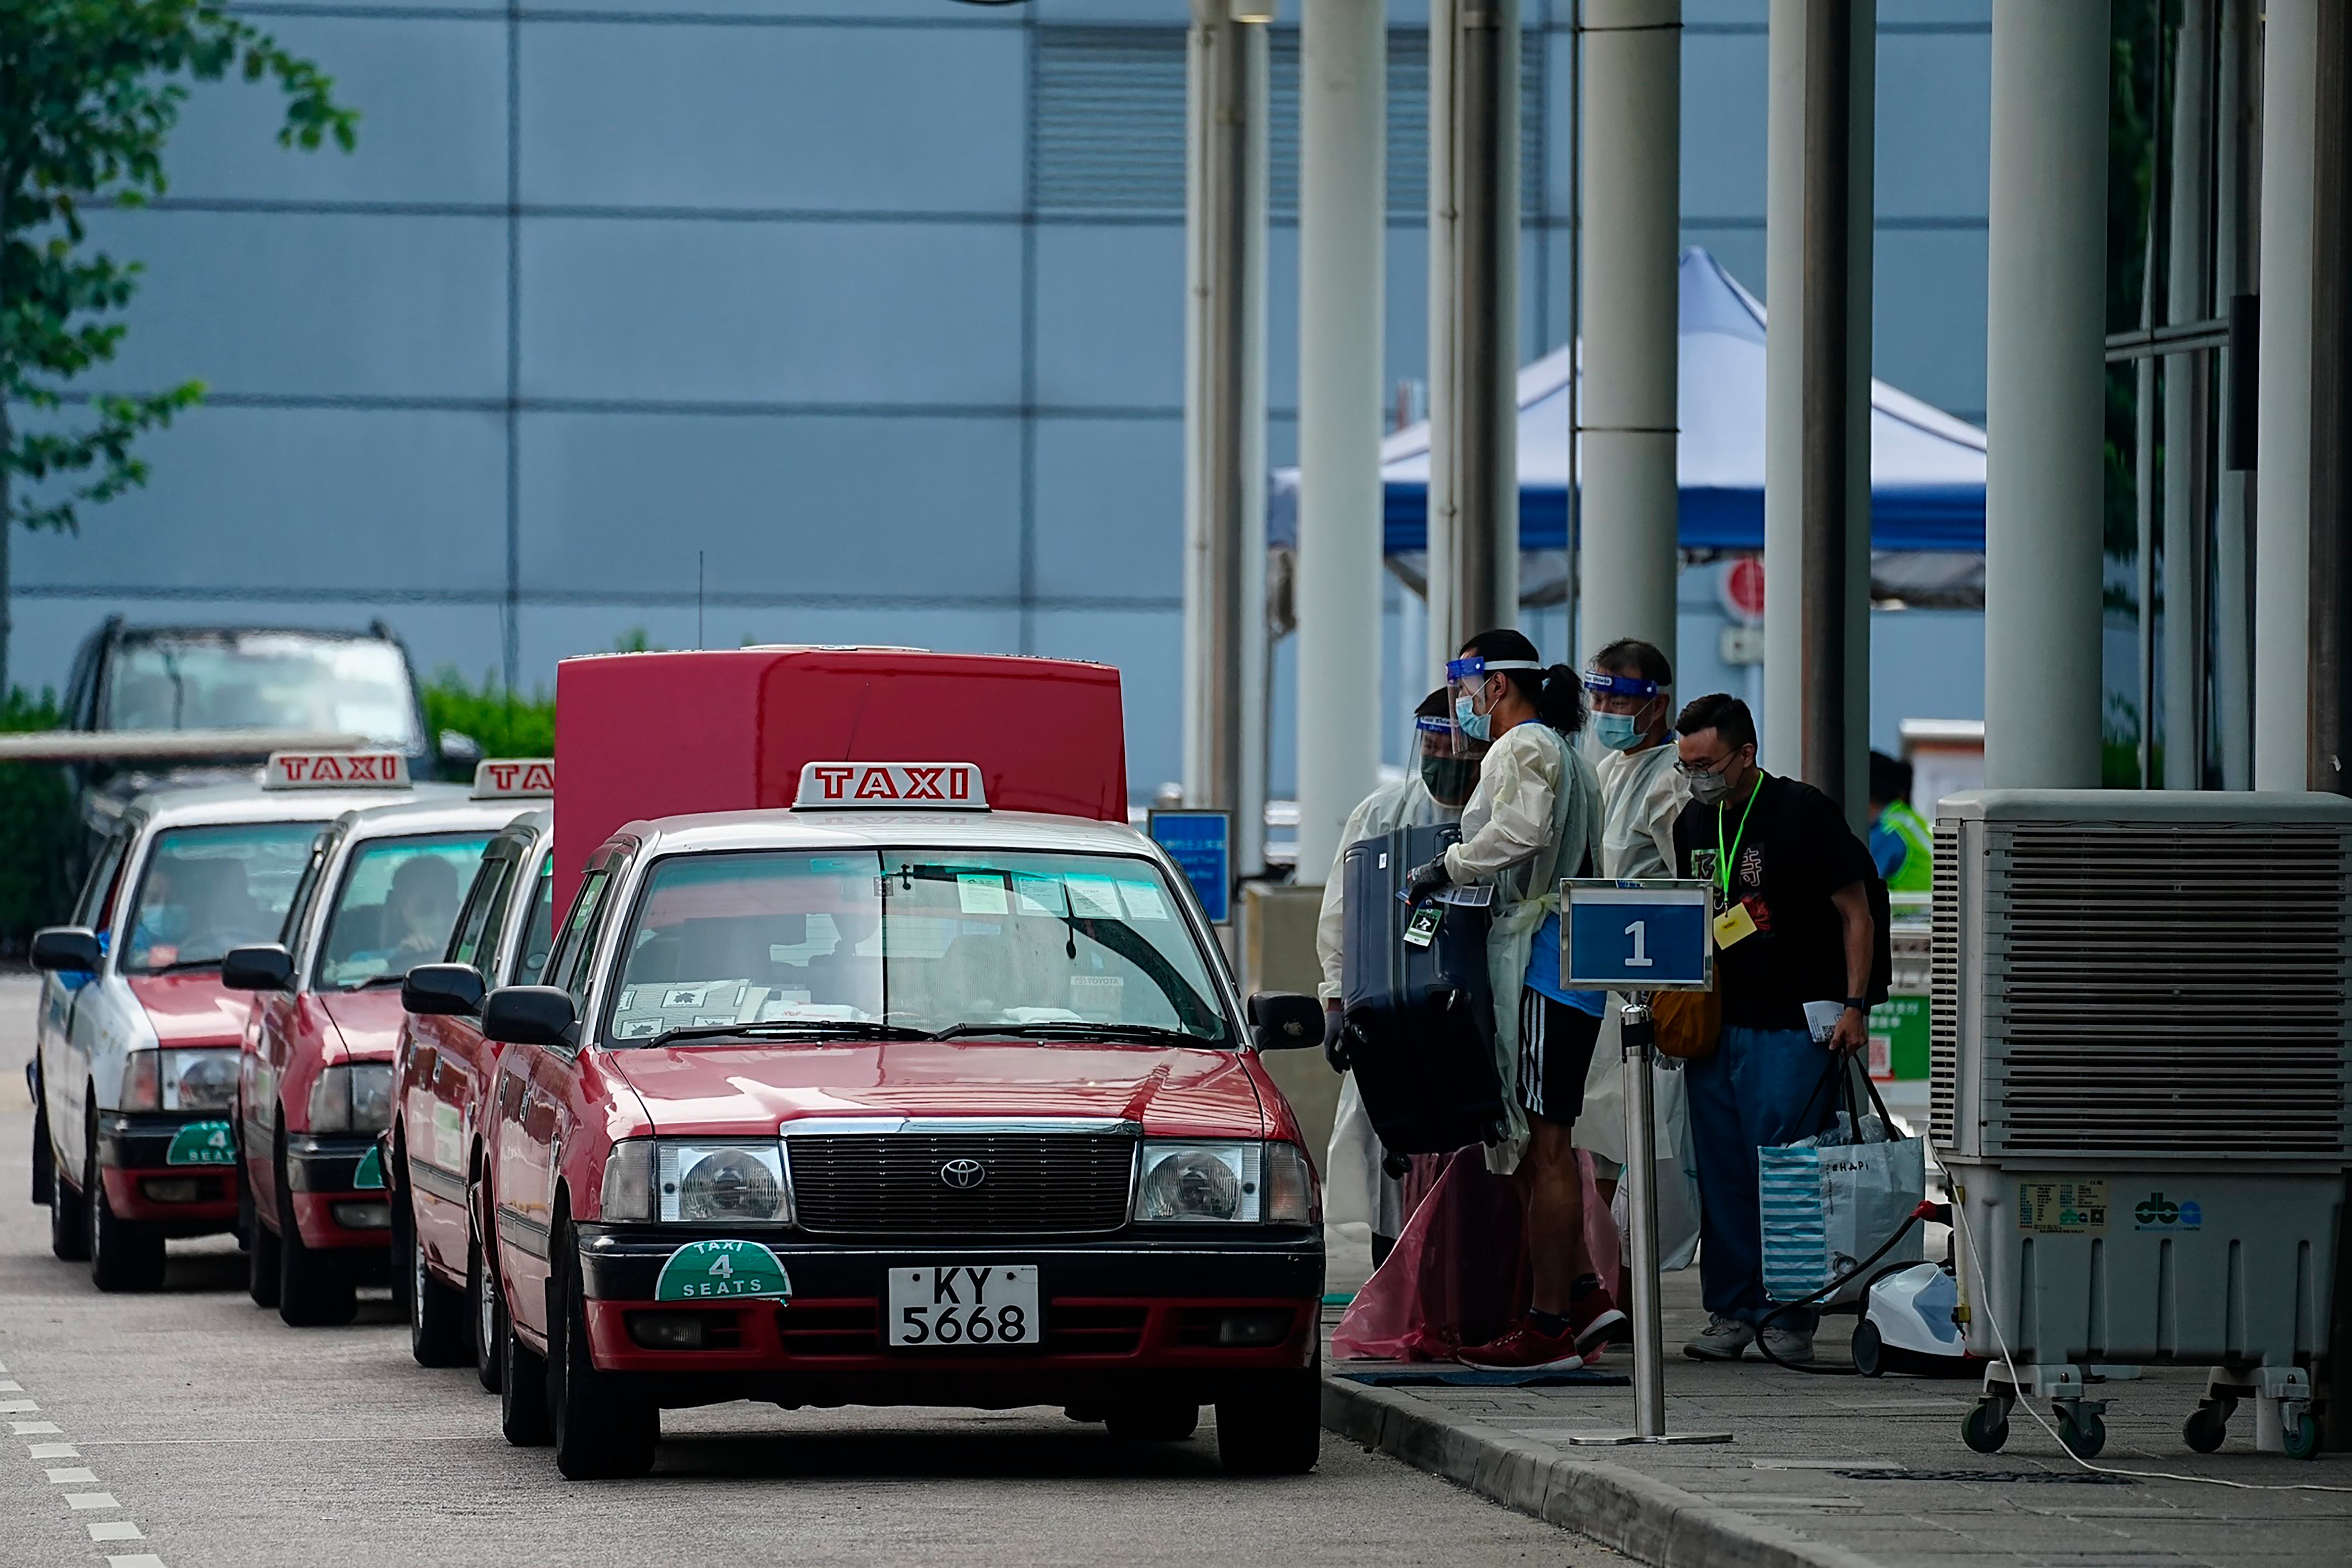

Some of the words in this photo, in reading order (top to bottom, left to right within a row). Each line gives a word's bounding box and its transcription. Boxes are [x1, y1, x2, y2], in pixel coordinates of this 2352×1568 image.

[280, 757, 396, 781] TAXI
[489, 765, 554, 791] TA
[815, 767, 968, 799] TAXI
[1625, 921, 1653, 966] 1
[208, 1131, 227, 1149] 4
[189, 1149, 236, 1161] SEAT
[693, 1241, 743, 1254] TAXI
[708, 1254, 733, 1279] 4
[683, 1279, 762, 1297] SEATS
[934, 1267, 992, 1305] KY
[902, 1305, 1026, 1344] 5668
